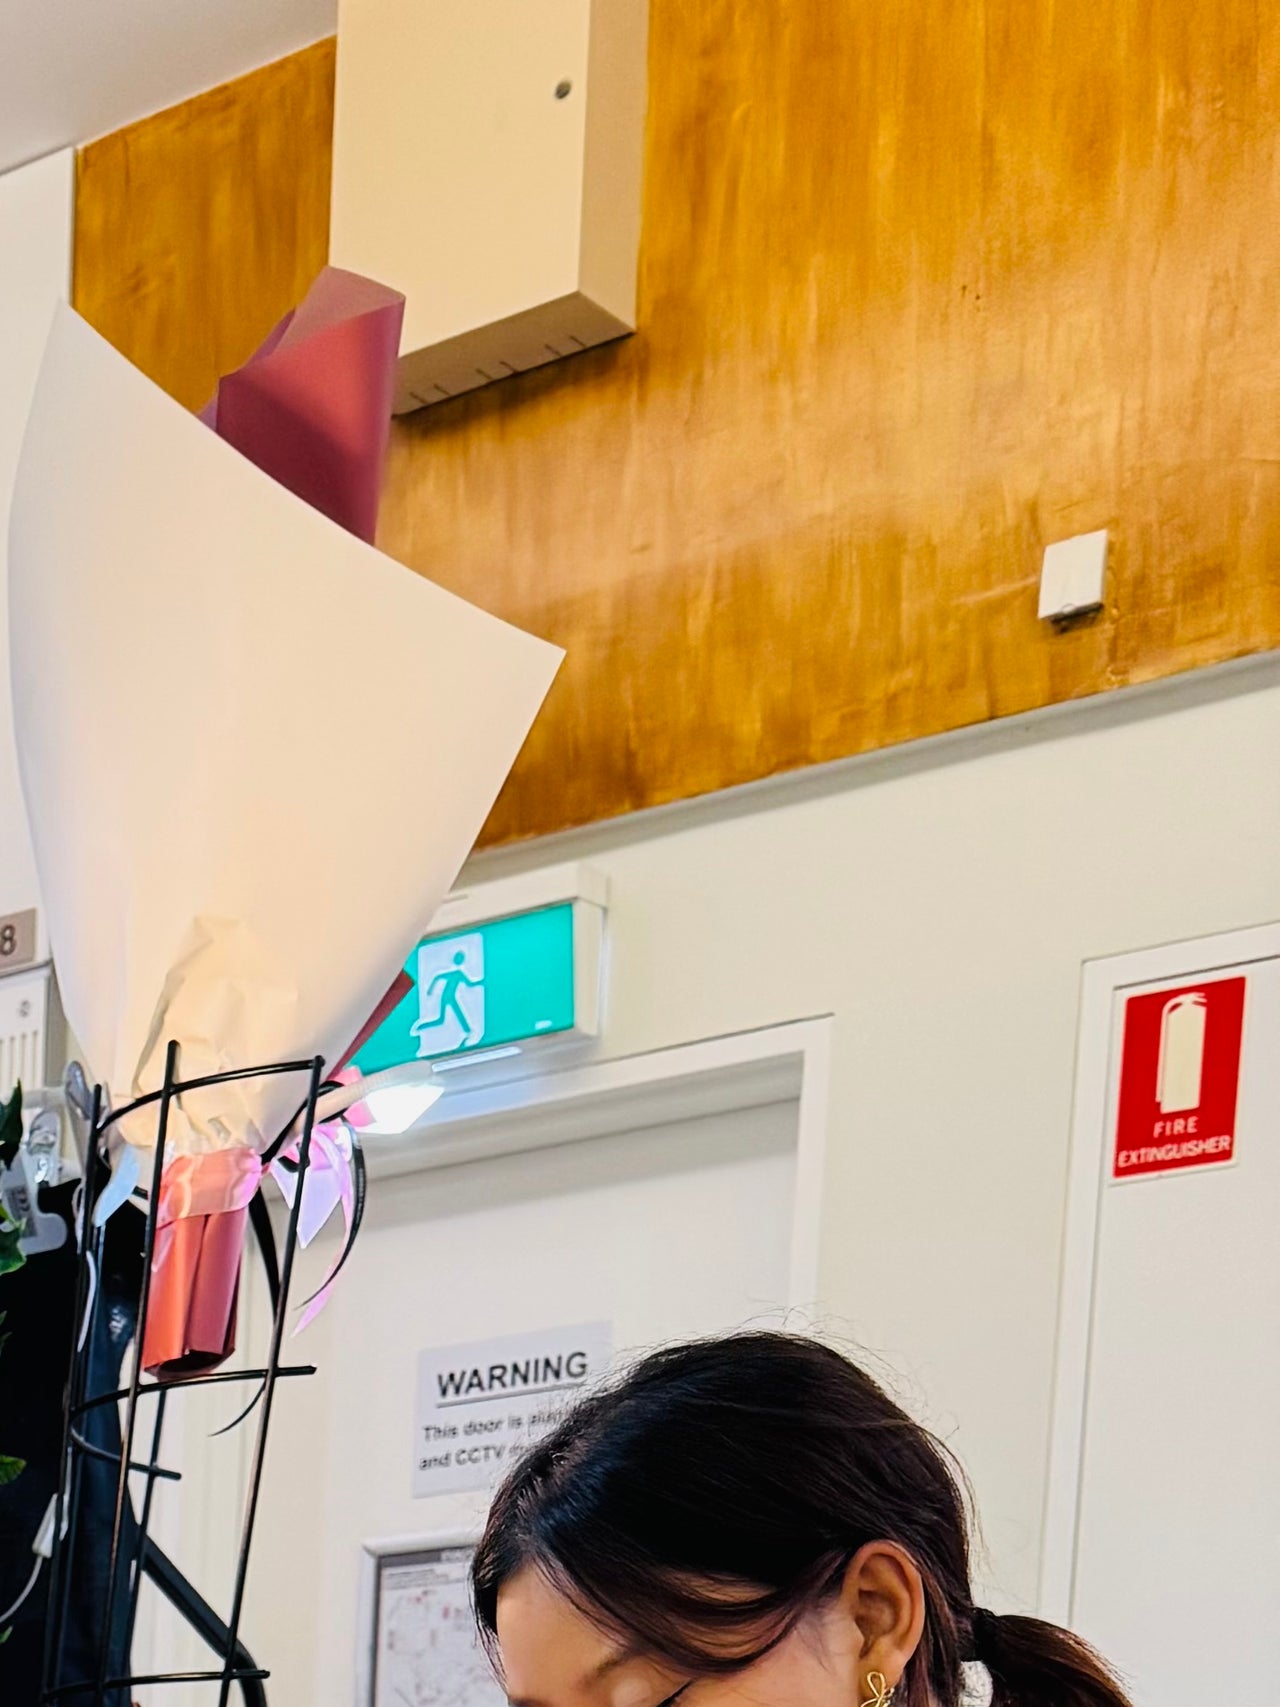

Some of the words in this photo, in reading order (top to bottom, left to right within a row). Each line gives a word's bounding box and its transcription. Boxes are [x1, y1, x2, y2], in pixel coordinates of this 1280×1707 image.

[1153, 1115, 1199, 1138] FIRE
[1117, 1134, 1232, 1168] EXTINGUISHER
[436, 1352, 589, 1399] WARNING
[422, 1425, 459, 1442] This
[463, 1418, 504, 1438] door
[419, 1452, 452, 1472] and
[455, 1444, 504, 1466] CCTV
